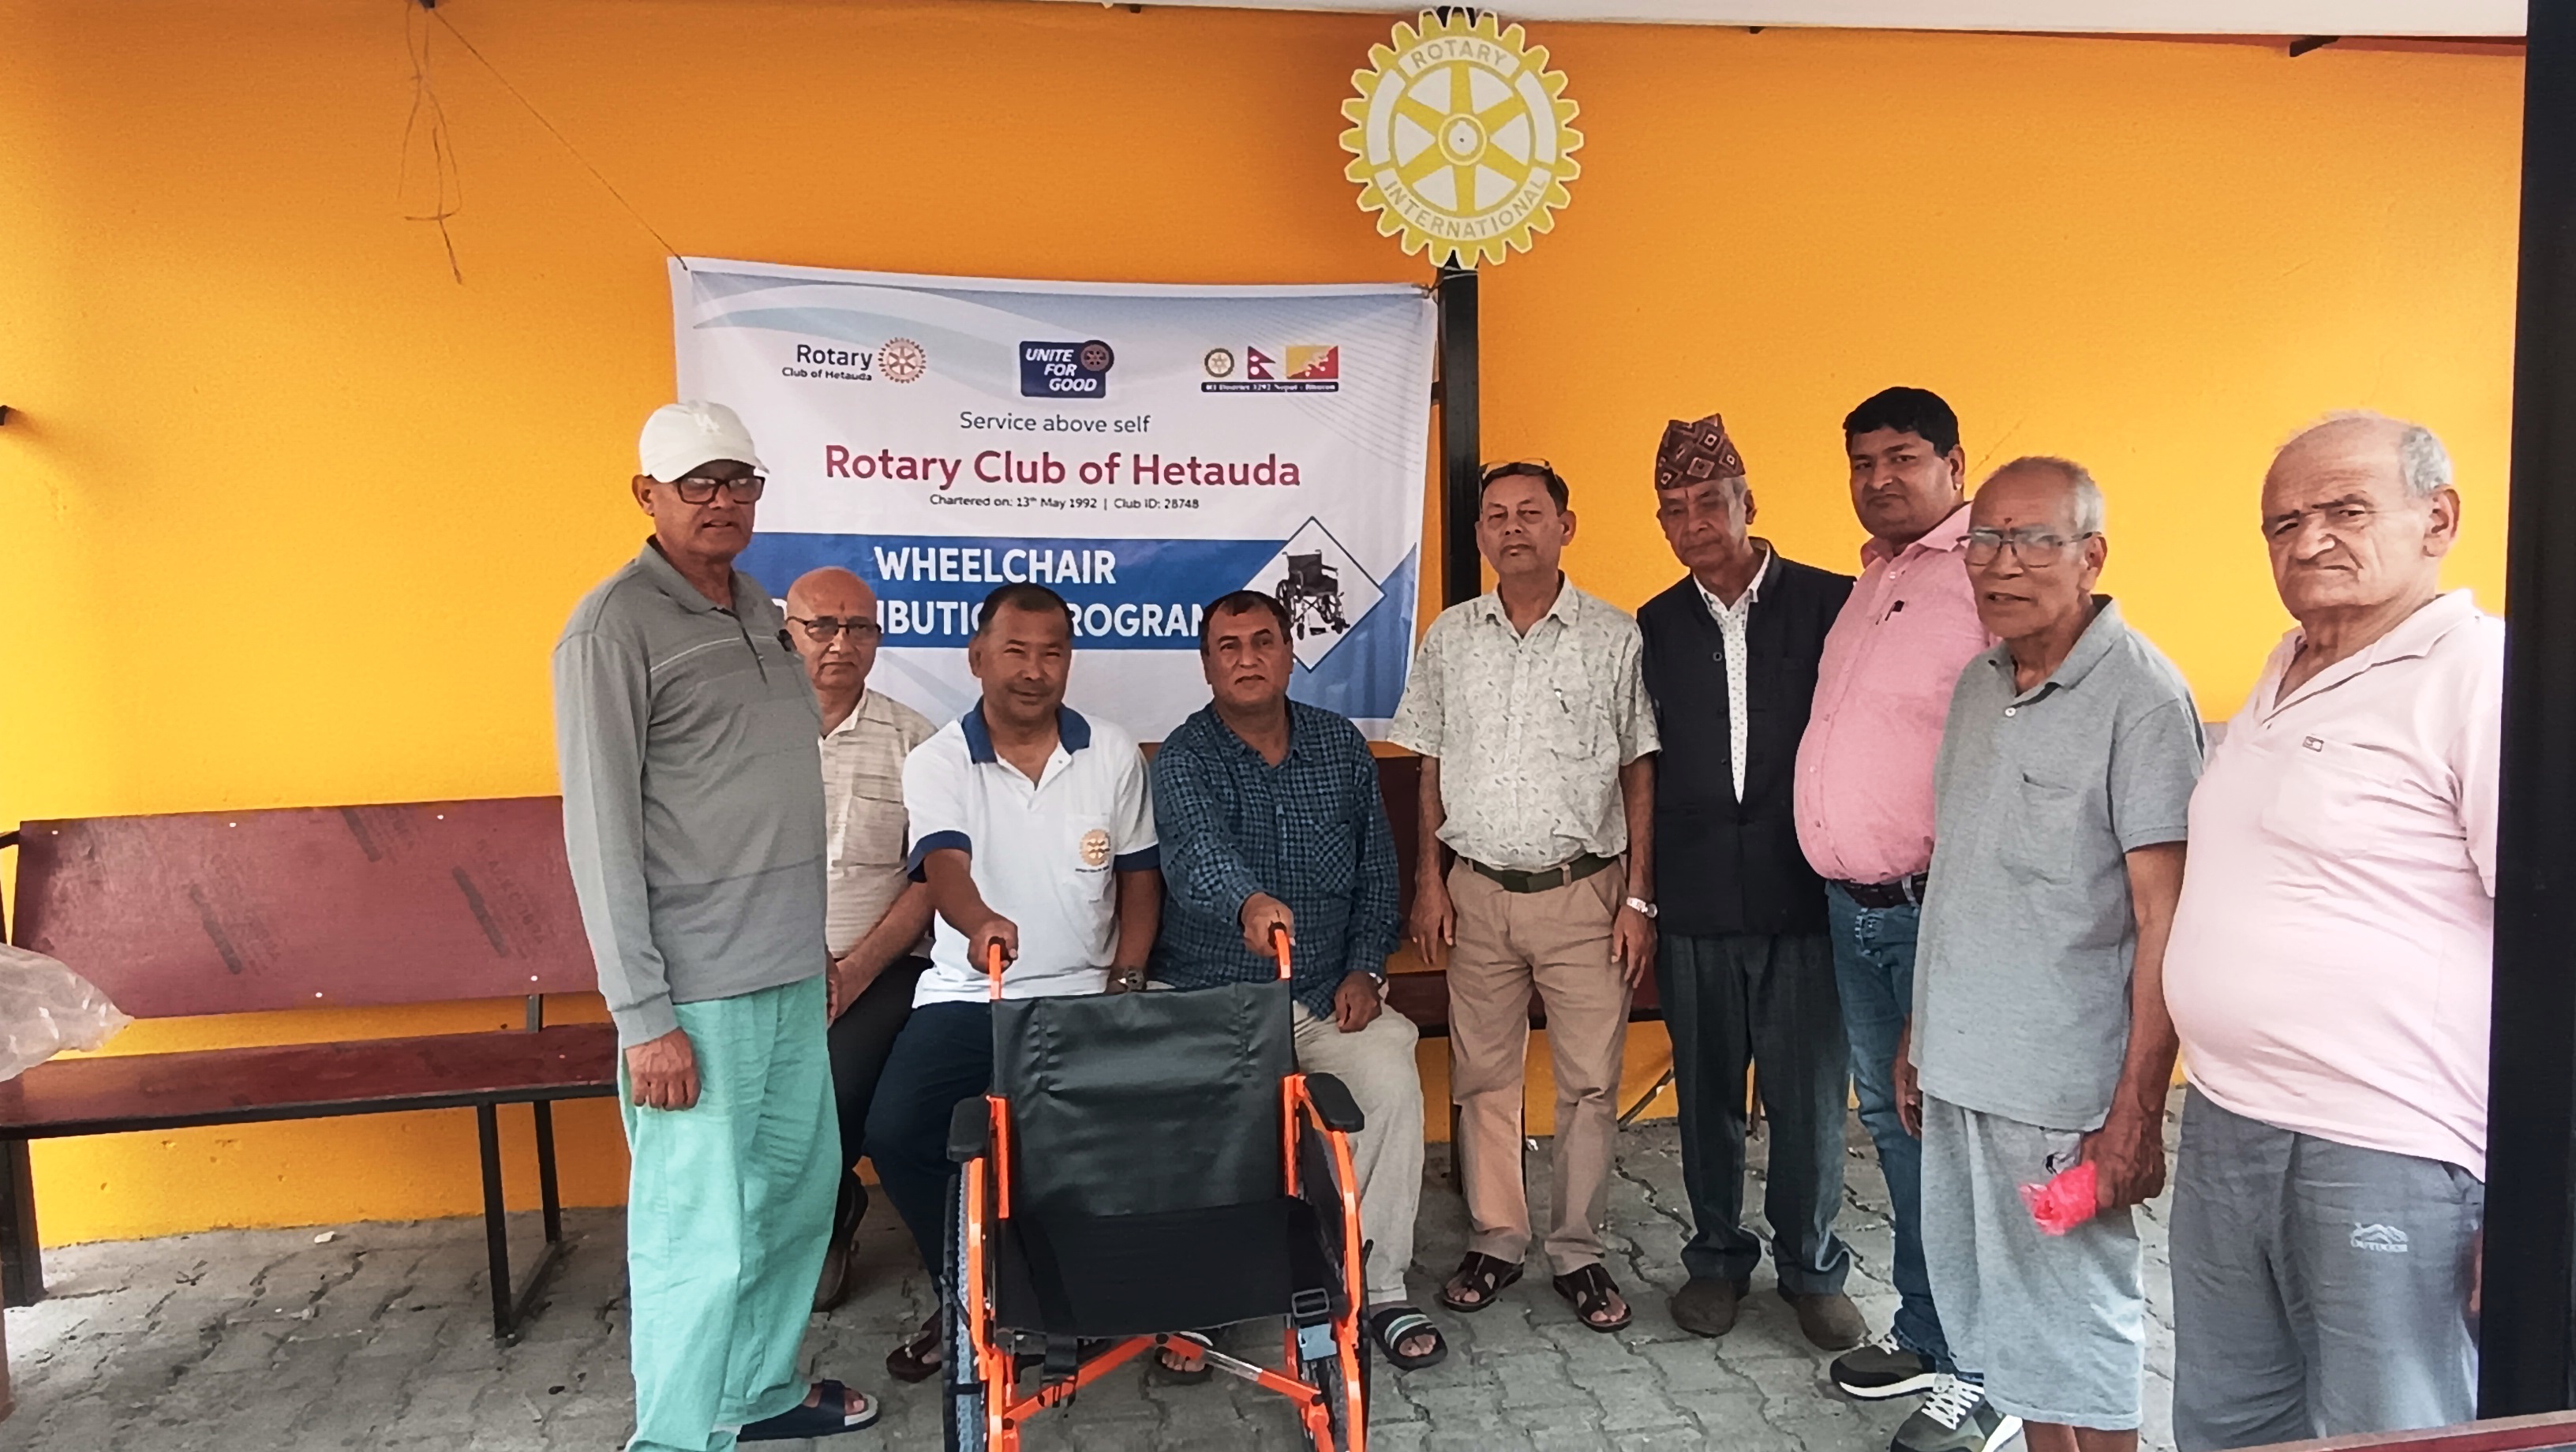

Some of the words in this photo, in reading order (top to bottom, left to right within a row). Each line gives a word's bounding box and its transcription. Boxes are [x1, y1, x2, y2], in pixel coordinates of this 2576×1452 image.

[1410, 39, 1507, 69] ROTARY
[1383, 179, 1548, 238] INTERNATIONAL
[796, 344, 873, 371] Rotary
[1025, 348, 1074, 362] UNITE
[781, 367, 808, 377] Club
[811, 369, 822, 378] of
[825, 370, 872, 381] Hetauda
[1044, 363, 1077, 376] FOR
[1048, 377, 1097, 391] GOOD
[960, 411, 1037, 431] Service
[1043, 414, 1107, 432] above
[1114, 415, 1151, 432] self
[826, 444, 962, 491] Rotary
[974, 450, 1066, 484] Club
[1079, 451, 1121, 485] of
[1133, 453, 1301, 486] Hetauda
[930, 494, 990, 506] Chartered
[1040, 498, 1066, 511] May
[1069, 498, 1098, 508] 1992
[1114, 498, 1141, 509] Club
[1164, 499, 1200, 509] 28748
[873, 546, 1117, 585] WHEELCHAIR
[1069, 603, 1205, 638] ROGRA
